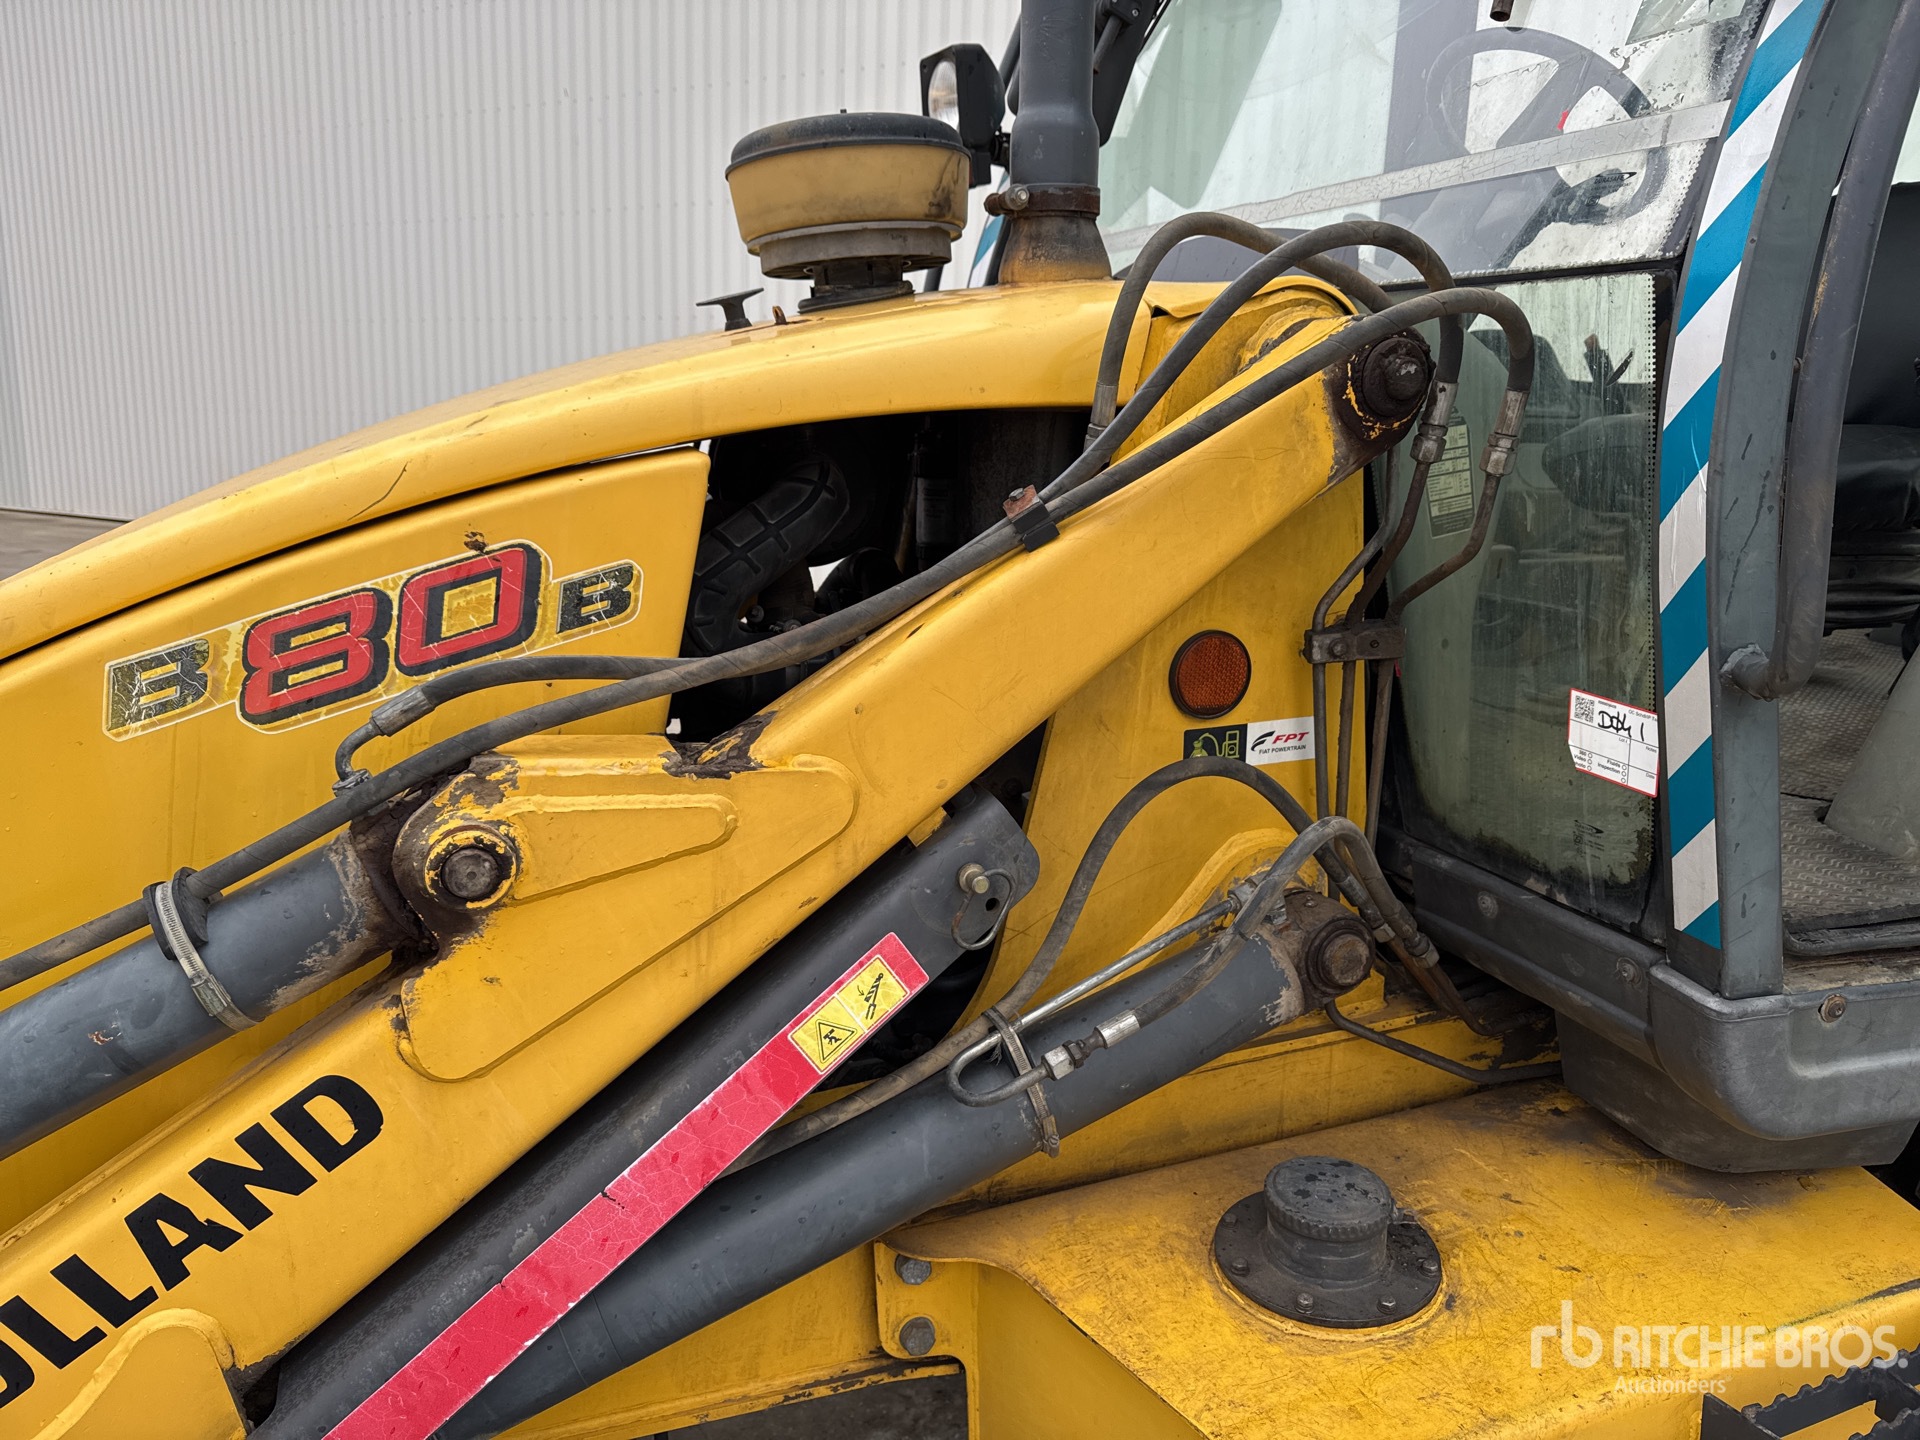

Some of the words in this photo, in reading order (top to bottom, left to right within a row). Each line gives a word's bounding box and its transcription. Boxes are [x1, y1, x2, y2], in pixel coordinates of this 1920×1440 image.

[1272, 731, 1310, 744] FPT
[1259, 747, 1271, 755] FIAT
[1271, 744, 1306, 754] POWERTRAIN
